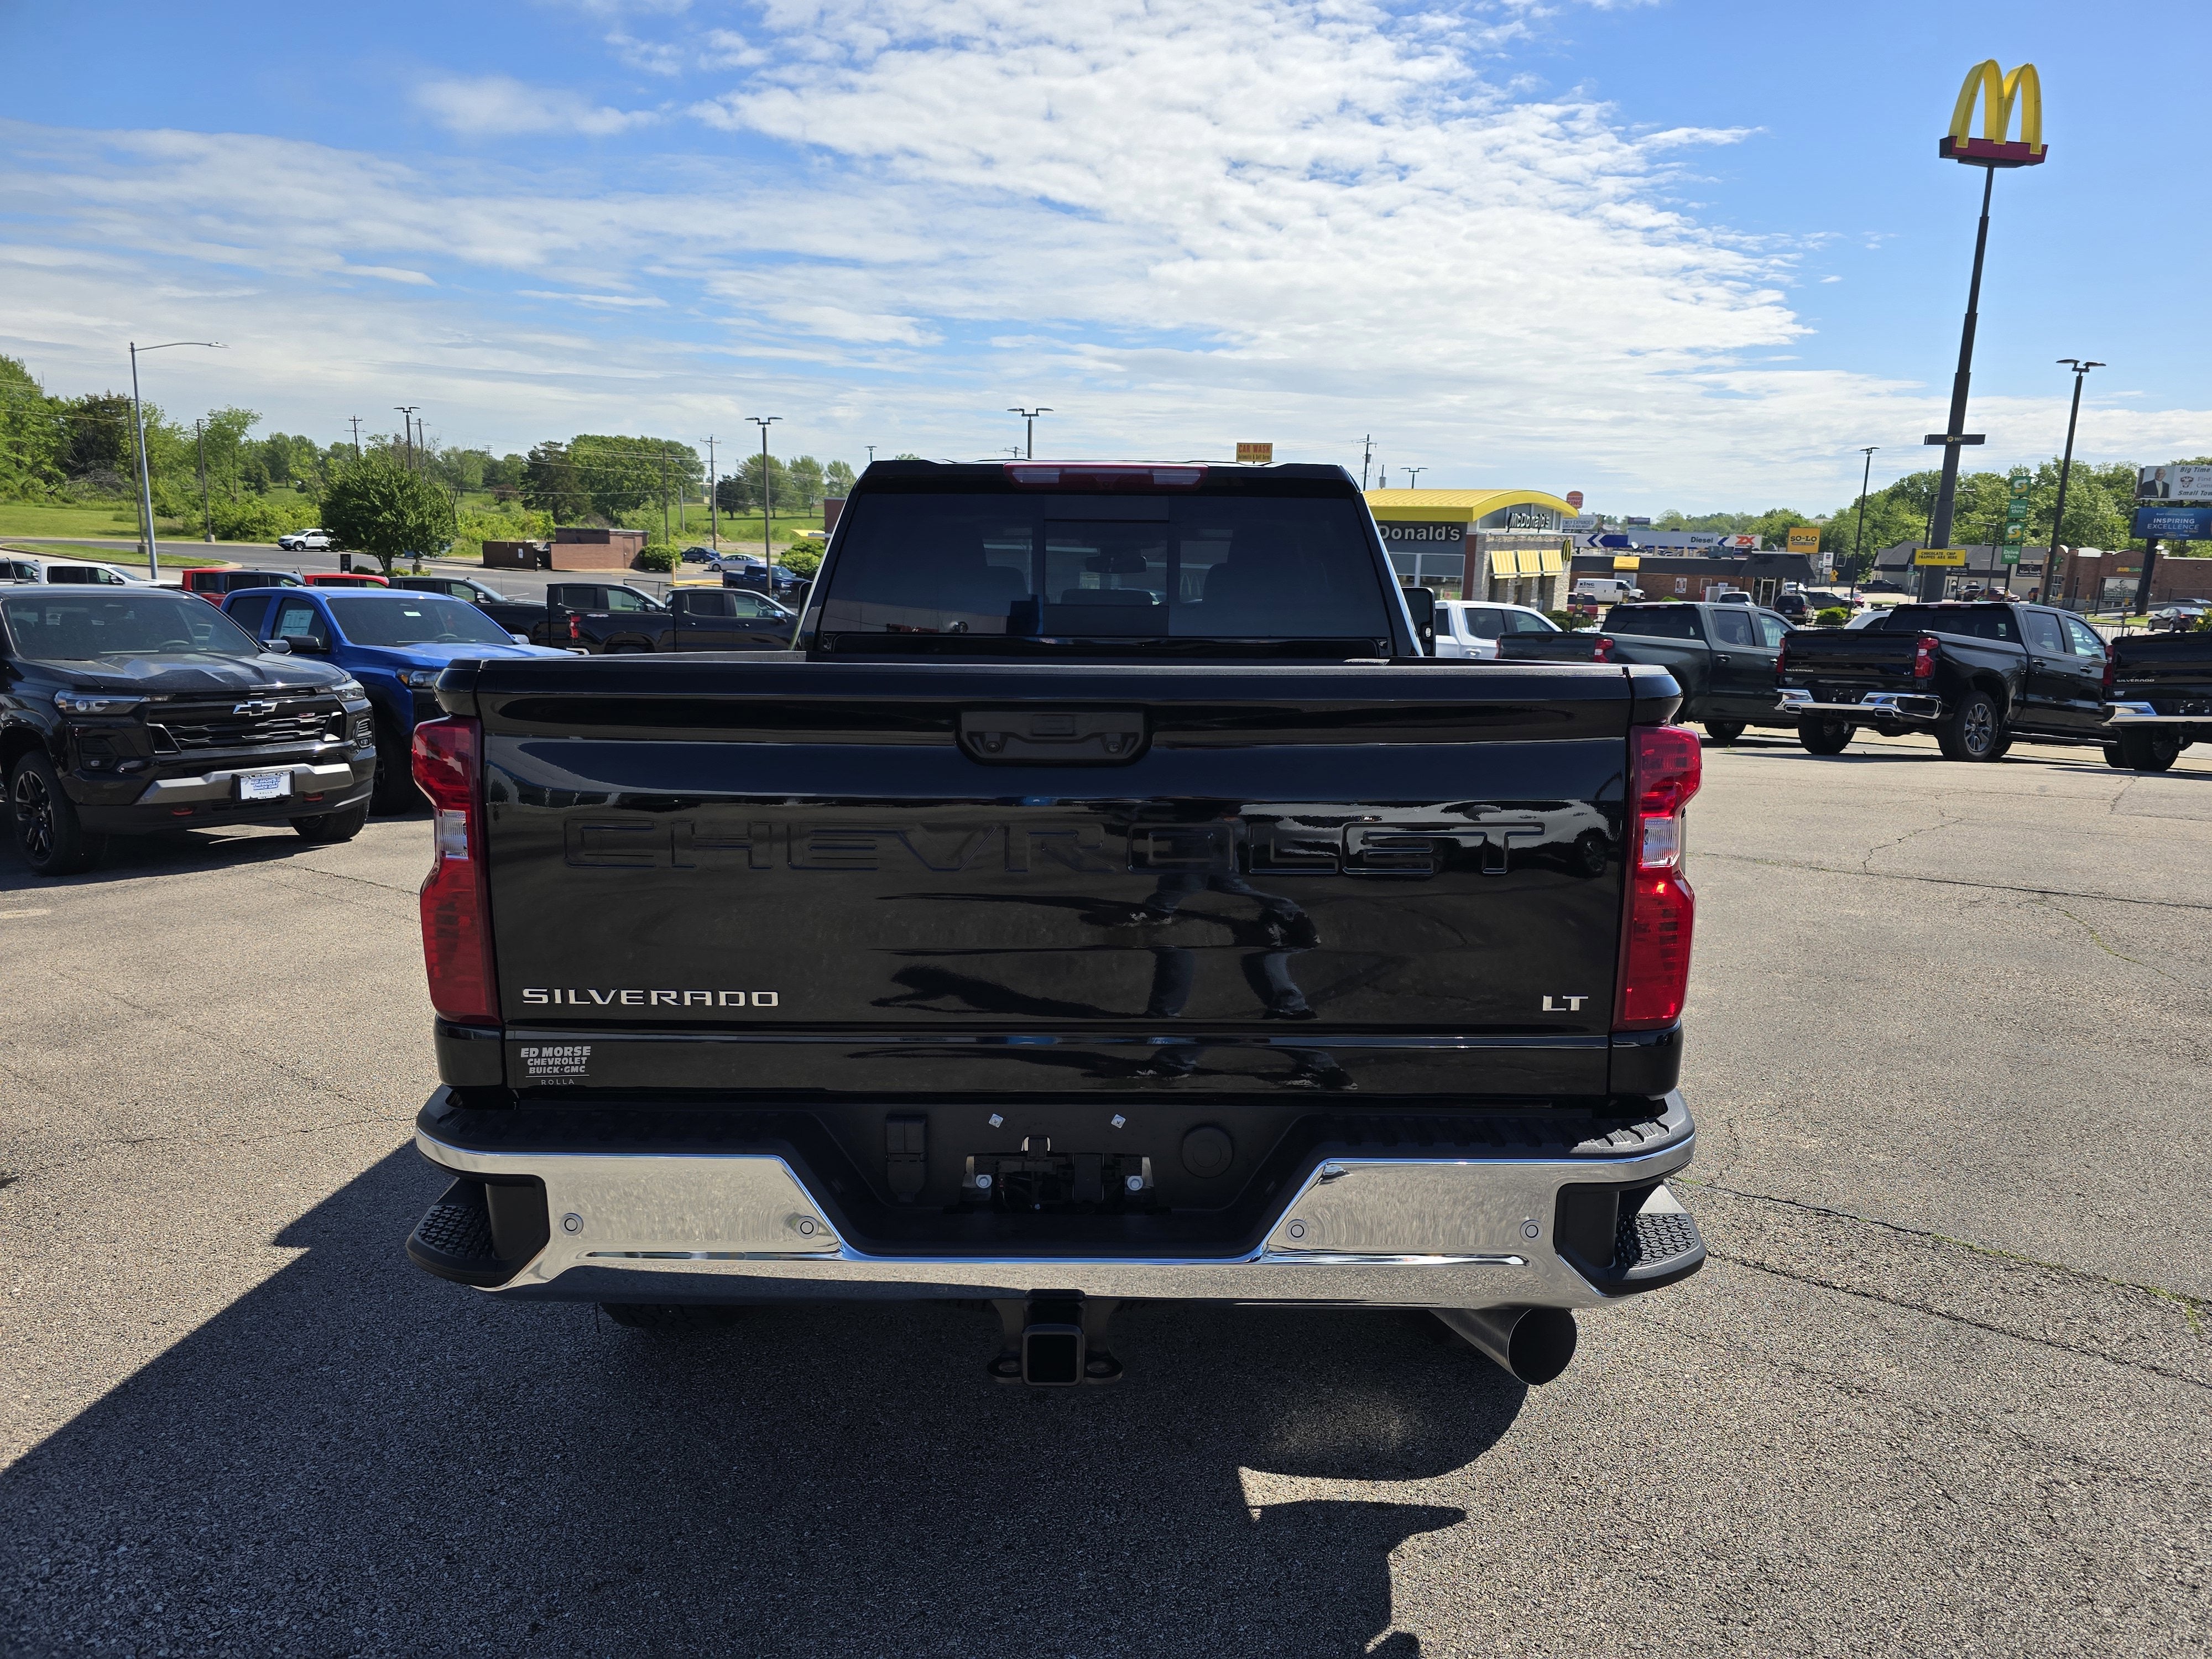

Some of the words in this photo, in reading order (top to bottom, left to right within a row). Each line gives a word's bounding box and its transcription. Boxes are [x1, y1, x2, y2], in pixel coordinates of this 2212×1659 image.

[1239, 445, 1250, 453] CAR
[1253, 445, 1270, 453] WASH
[1379, 525, 1460, 541] Donald's
[564, 818, 1545, 875] CHEVROLET
[522, 988, 779, 1006] SILVERADO
[1542, 995, 1589, 1011] LT
[520, 1047, 539, 1058] ED
[541, 1046, 591, 1057] MORSE
[527, 1057, 587, 1066] CHEVROLET
